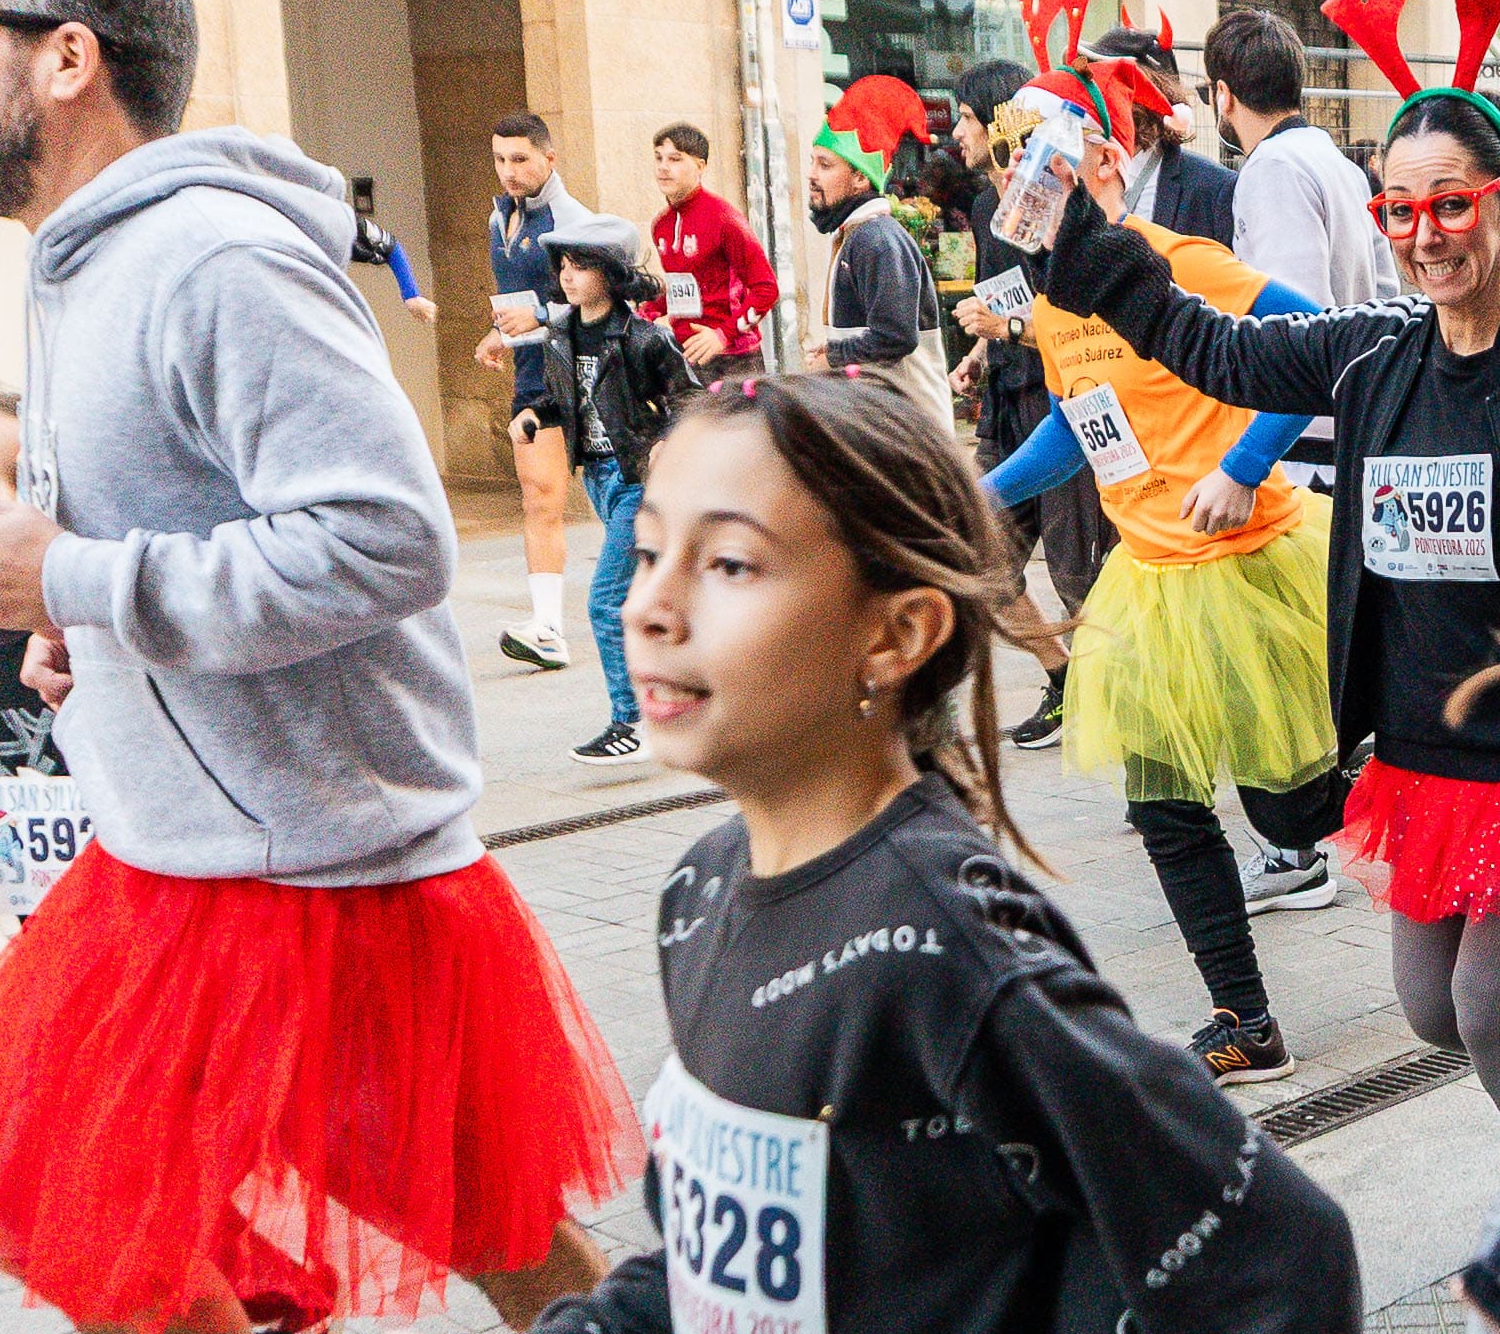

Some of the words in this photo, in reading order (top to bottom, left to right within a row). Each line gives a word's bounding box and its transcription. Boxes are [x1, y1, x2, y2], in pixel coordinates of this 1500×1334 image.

[1002, 285, 1030, 312] 3701
[1085, 347, 1124, 364] Suárez
[1079, 413, 1122, 452] 564
[1395, 463, 1422, 487] SAN
[1425, 461, 1485, 487] SILVESTRE
[1407, 490, 1485, 533] 5926
[1414, 537, 1464, 556] PONTEVEDRA
[1465, 538, 1486, 556] 2025
[8, 782, 38, 812] SAN
[673, 1160, 800, 1304] 5328
